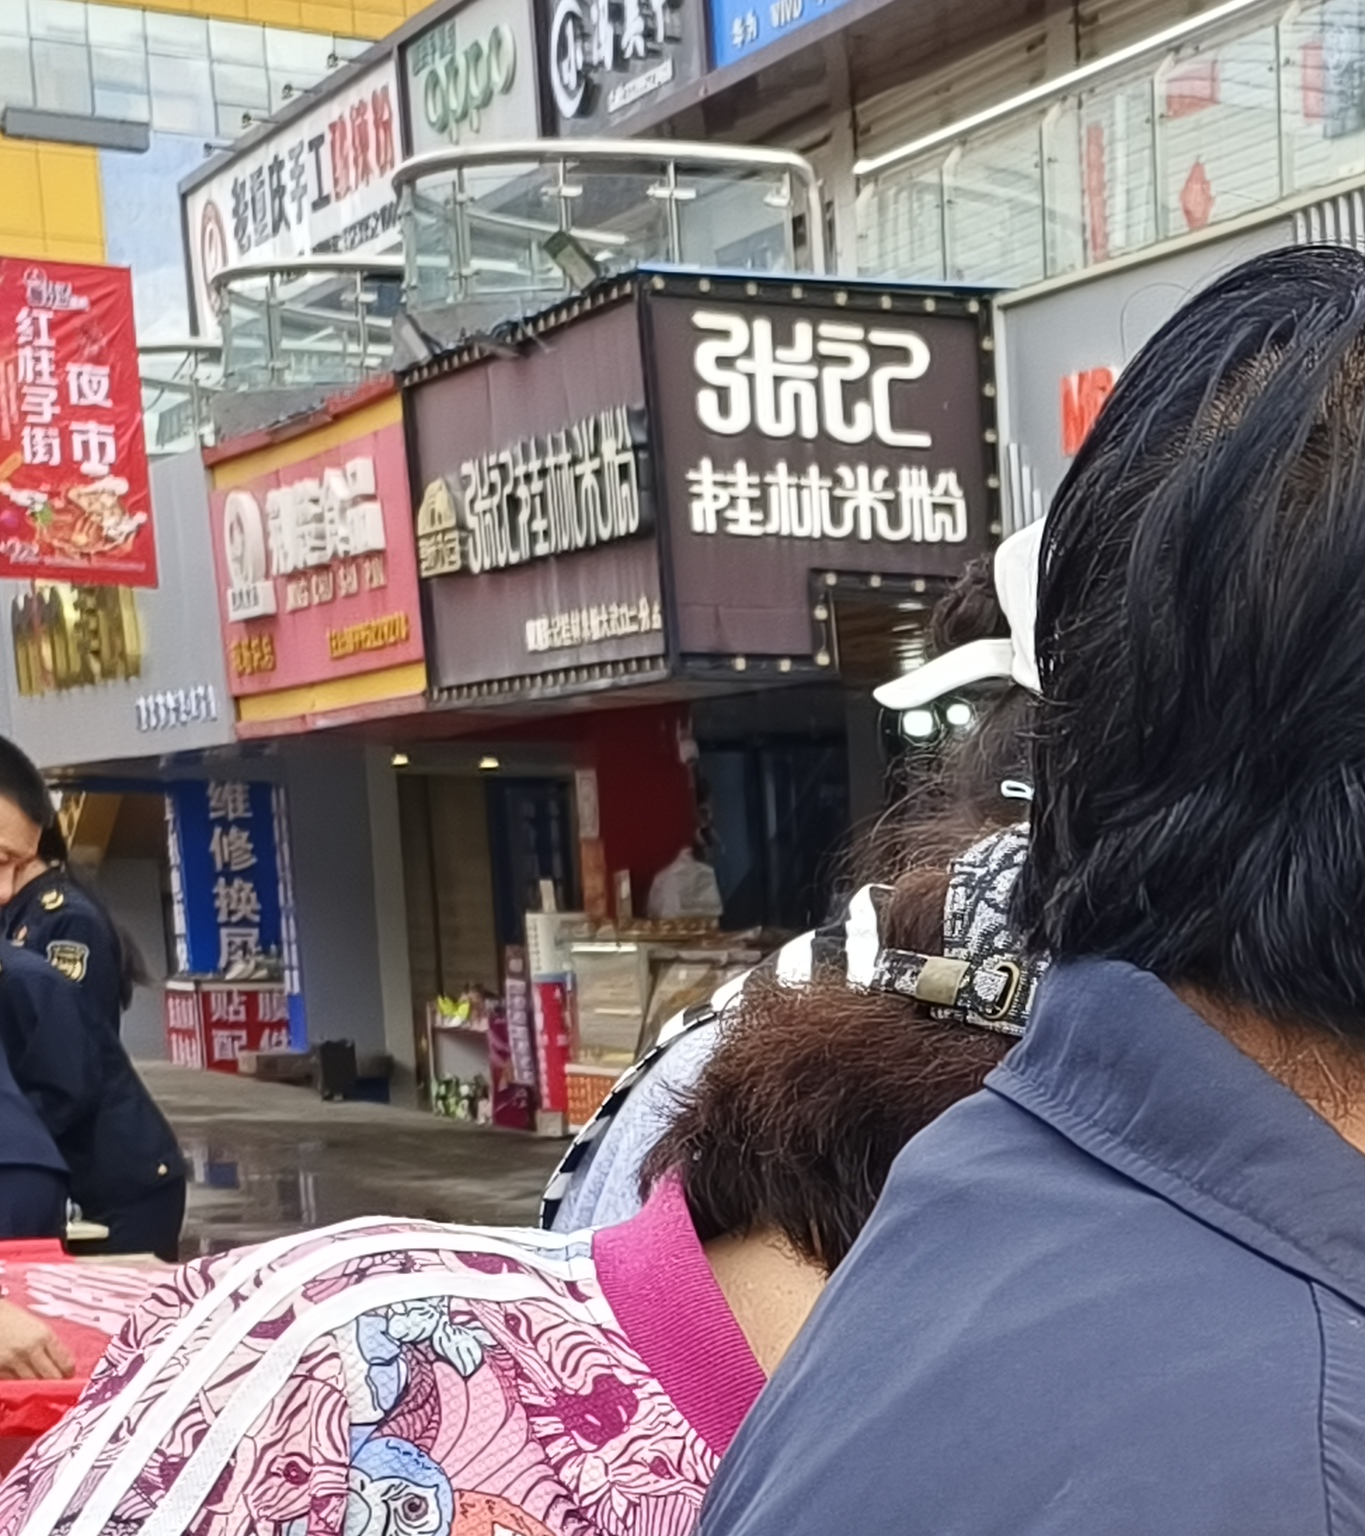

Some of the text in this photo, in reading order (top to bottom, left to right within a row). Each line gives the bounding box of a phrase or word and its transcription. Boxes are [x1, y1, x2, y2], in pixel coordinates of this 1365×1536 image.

[15, 306, 62, 466] 红柱子街
[65, 361, 117, 478] 夜市
[691, 310, 931, 447] 张记
[460, 404, 640, 575] 张记桂林米粉
[685, 457, 967, 543] 桂林米粉
